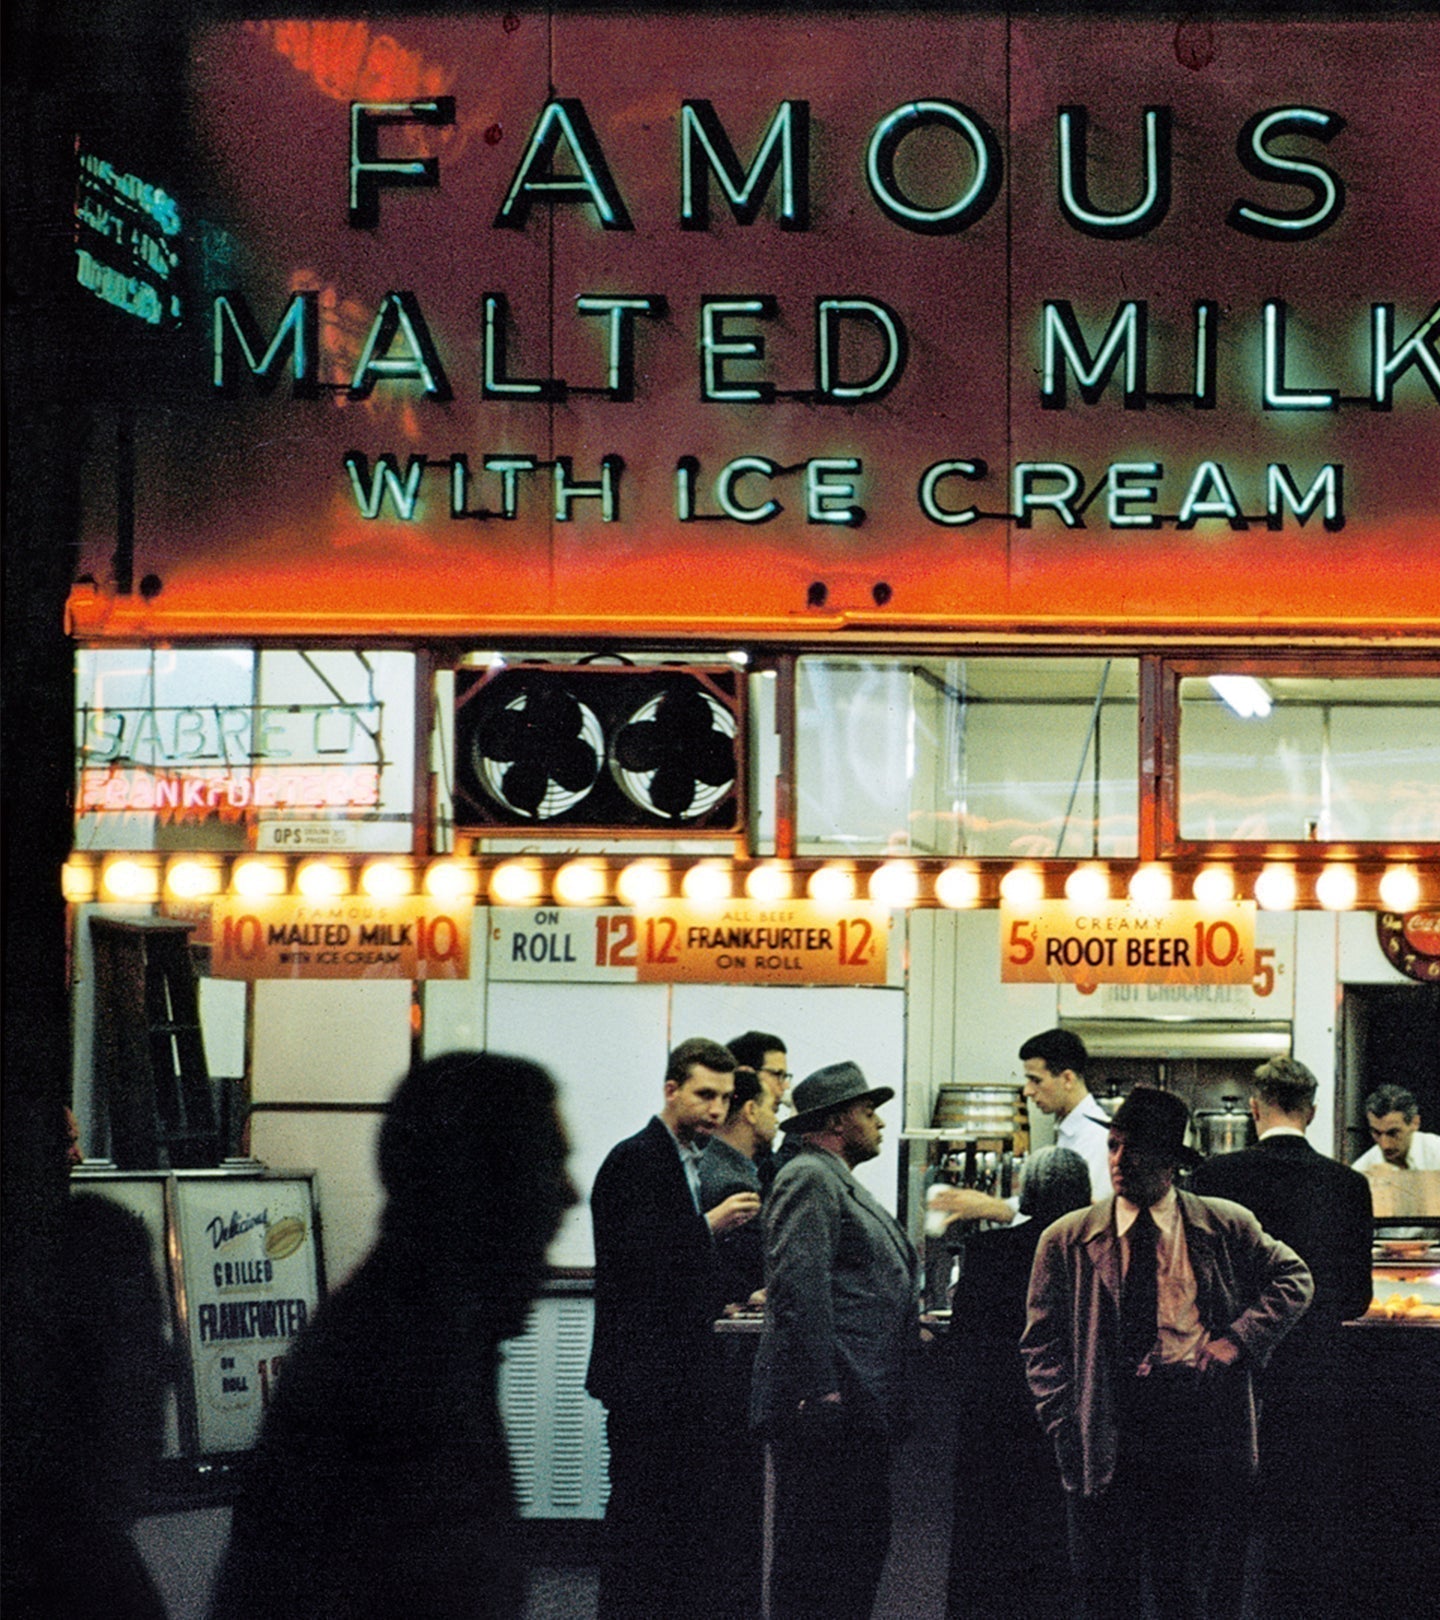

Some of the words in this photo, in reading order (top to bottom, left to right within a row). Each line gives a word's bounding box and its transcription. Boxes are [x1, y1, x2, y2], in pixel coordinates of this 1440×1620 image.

[348, 97, 1346, 240] FAMOUS
[210, 290, 909, 405] MALTED
[345, 450, 625, 522] WITH
[676, 455, 866, 528] ICE
[919, 458, 1346, 532] CREAM
[274, 828, 302, 844] OPS
[534, 912, 559, 925] ON
[721, 911, 751, 923] ALL
[760, 911, 796, 922] BEEF
[1075, 916, 1164, 931] CREAMY
[268, 924, 350, 947] MALTED
[358, 924, 413, 947] MILK
[512, 932, 576, 963] ROLL
[595, 915, 637, 967] 12
[687, 927, 833, 951] FRANKFURTER
[316, 952, 340, 965] ICE
[342, 951, 400, 965] CREAM
[717, 955, 745, 970] ON
[756, 955, 804, 970] ROLL
[1046, 937, 1116, 966] ROOT
[1127, 939, 1190, 967] BEER
[213, 1259, 273, 1287] GRILLED
[199, 1299, 308, 1341] FRANKFURTER
